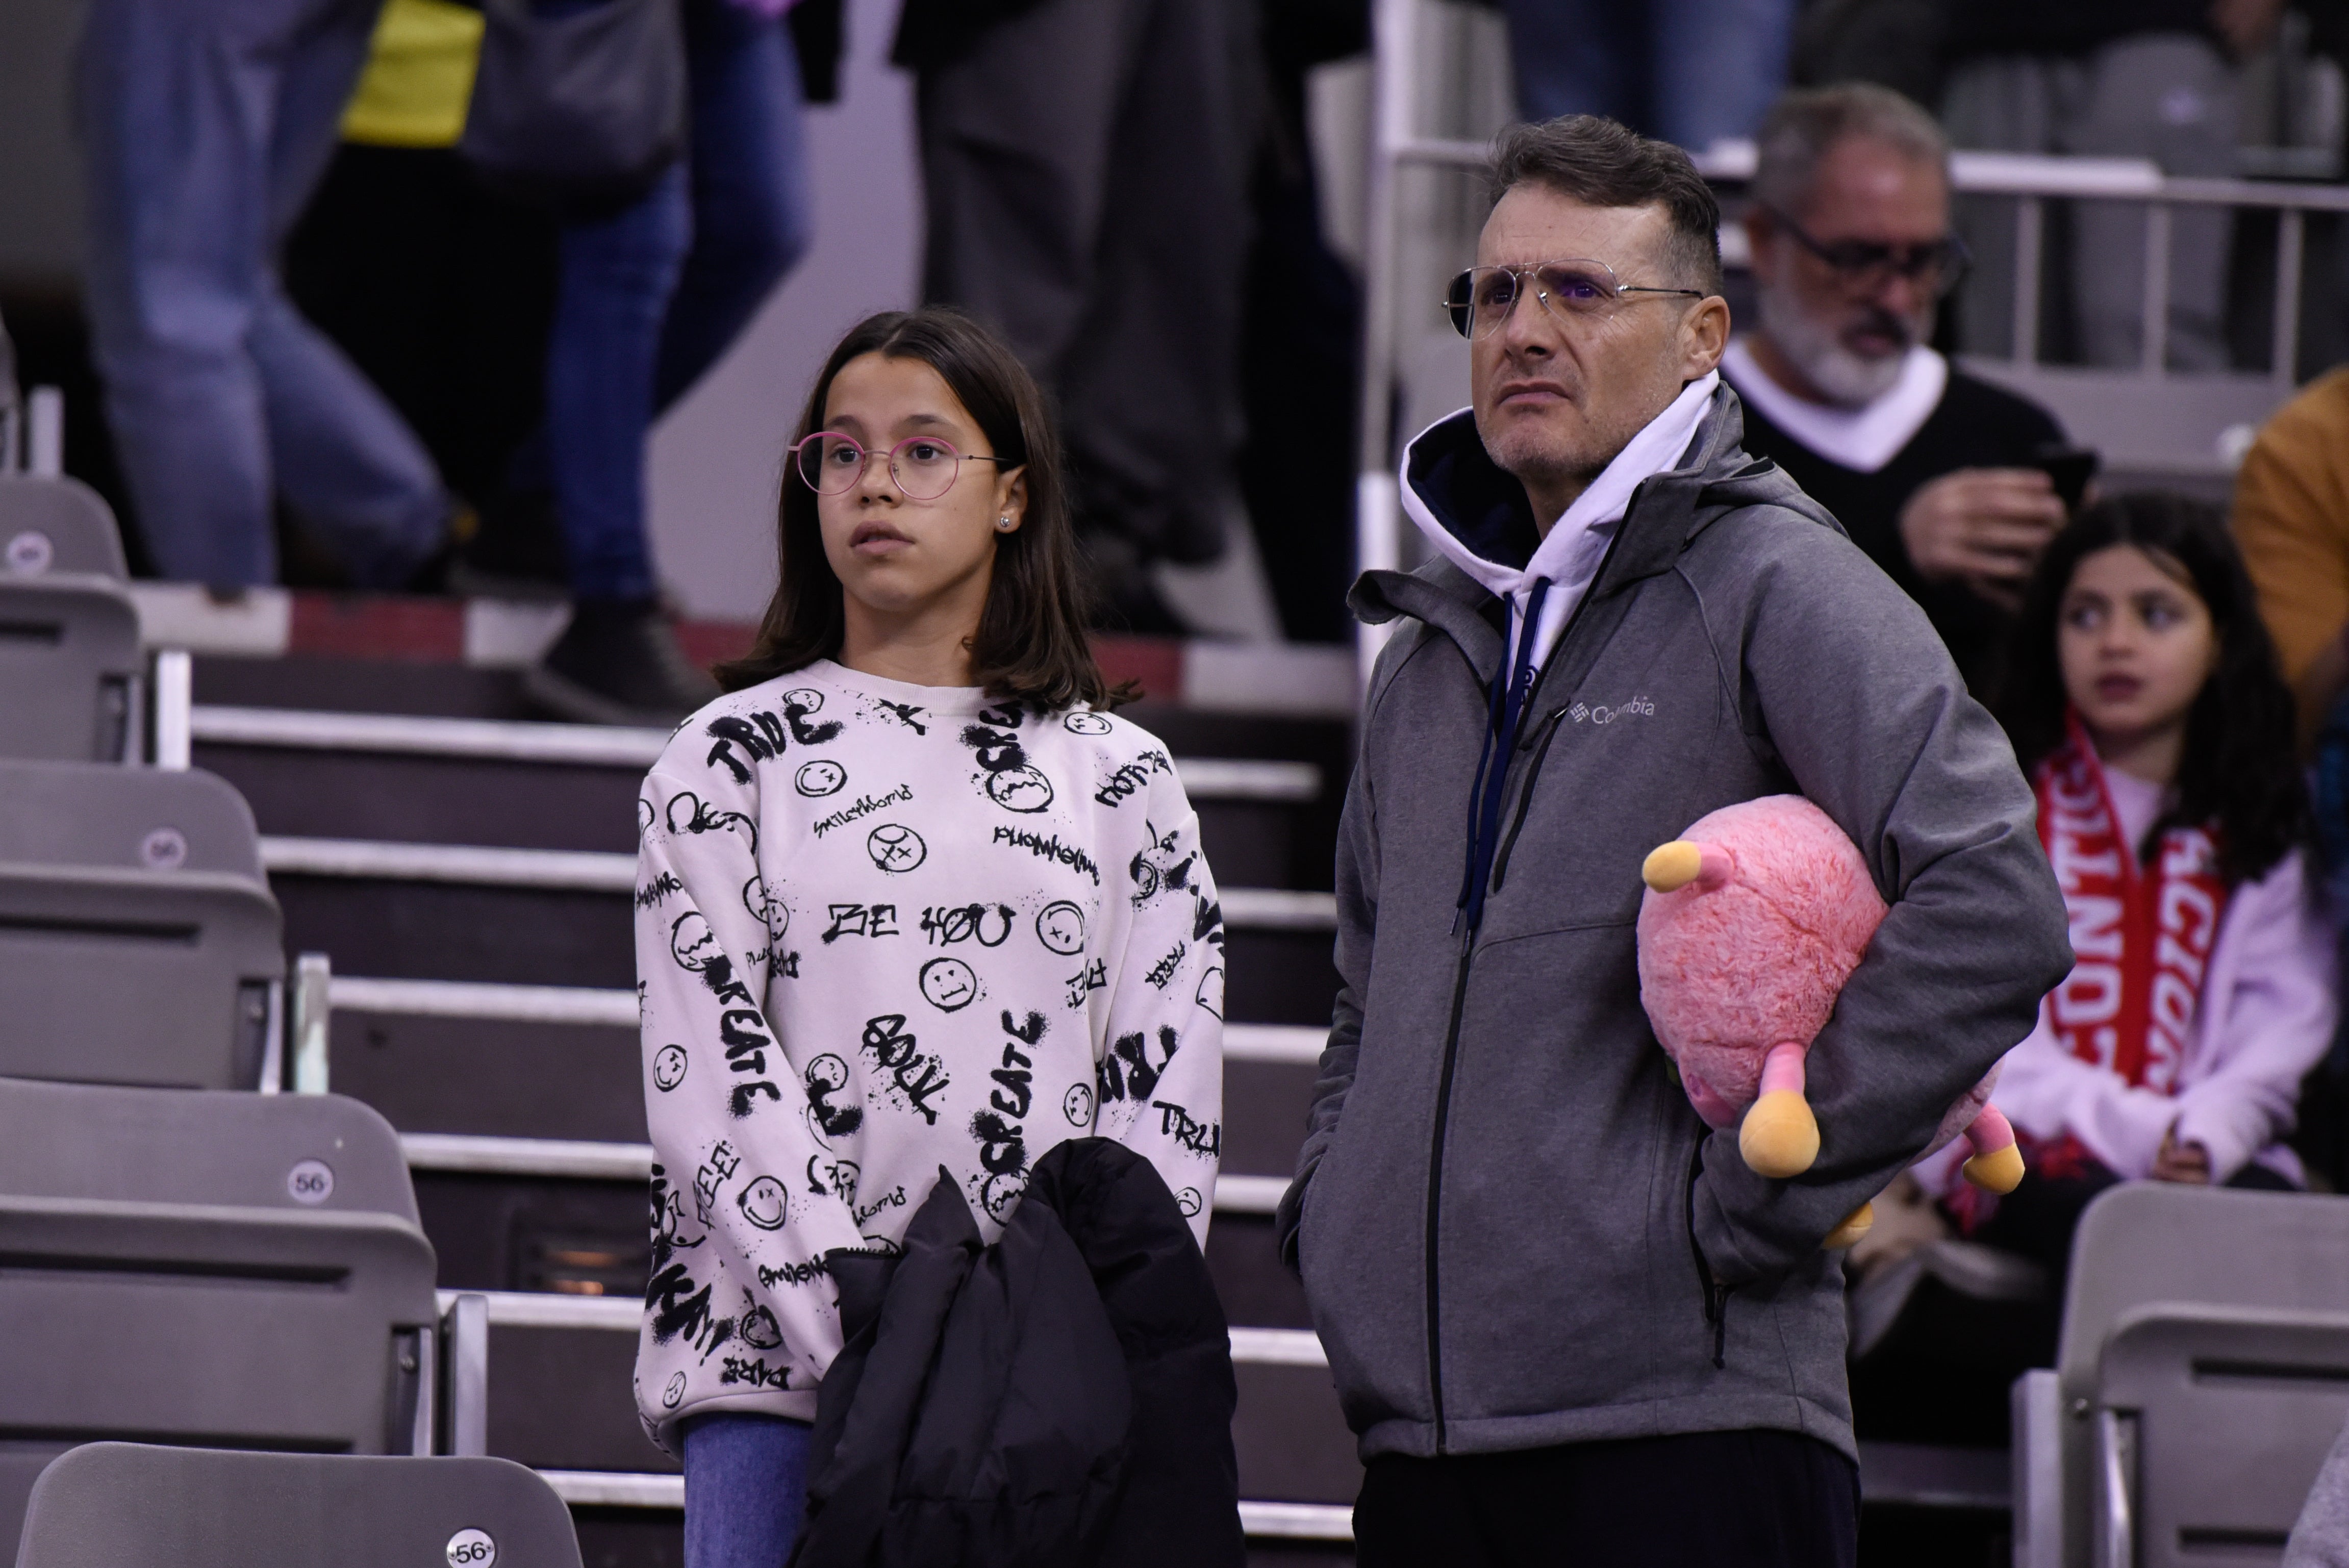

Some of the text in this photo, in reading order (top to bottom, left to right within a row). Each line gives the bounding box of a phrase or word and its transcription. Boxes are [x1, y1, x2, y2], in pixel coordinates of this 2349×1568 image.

[1593, 696, 1654, 724] Colmbia
[971, 1009, 1048, 1173] CREATE
[297, 1175, 324, 1192] 56
[456, 1540, 487, 1564] 56
